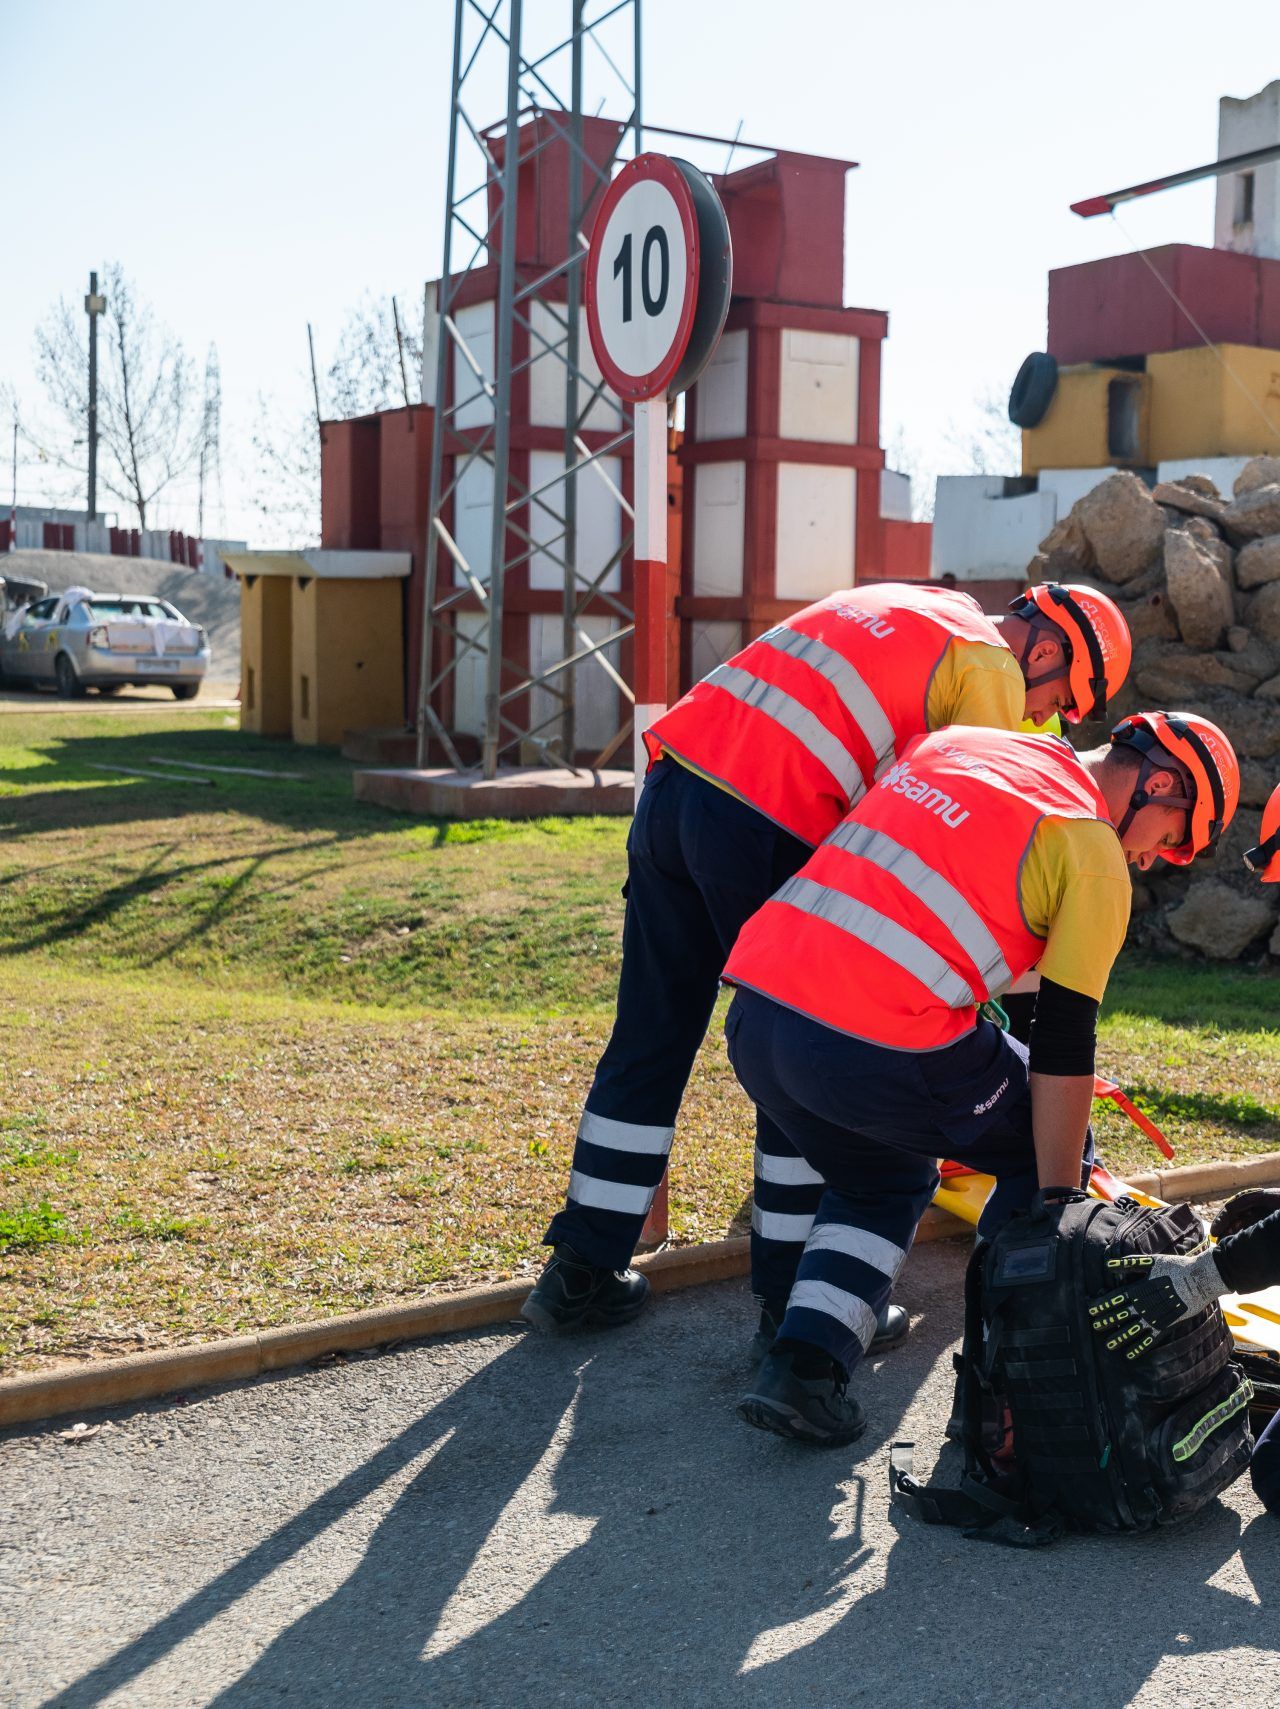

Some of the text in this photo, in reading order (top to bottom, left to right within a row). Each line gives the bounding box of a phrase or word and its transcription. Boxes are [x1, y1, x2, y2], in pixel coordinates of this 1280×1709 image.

[613, 225, 670, 323] 10
[893, 775, 970, 829] samu
[985, 1077, 1009, 1110] samu
